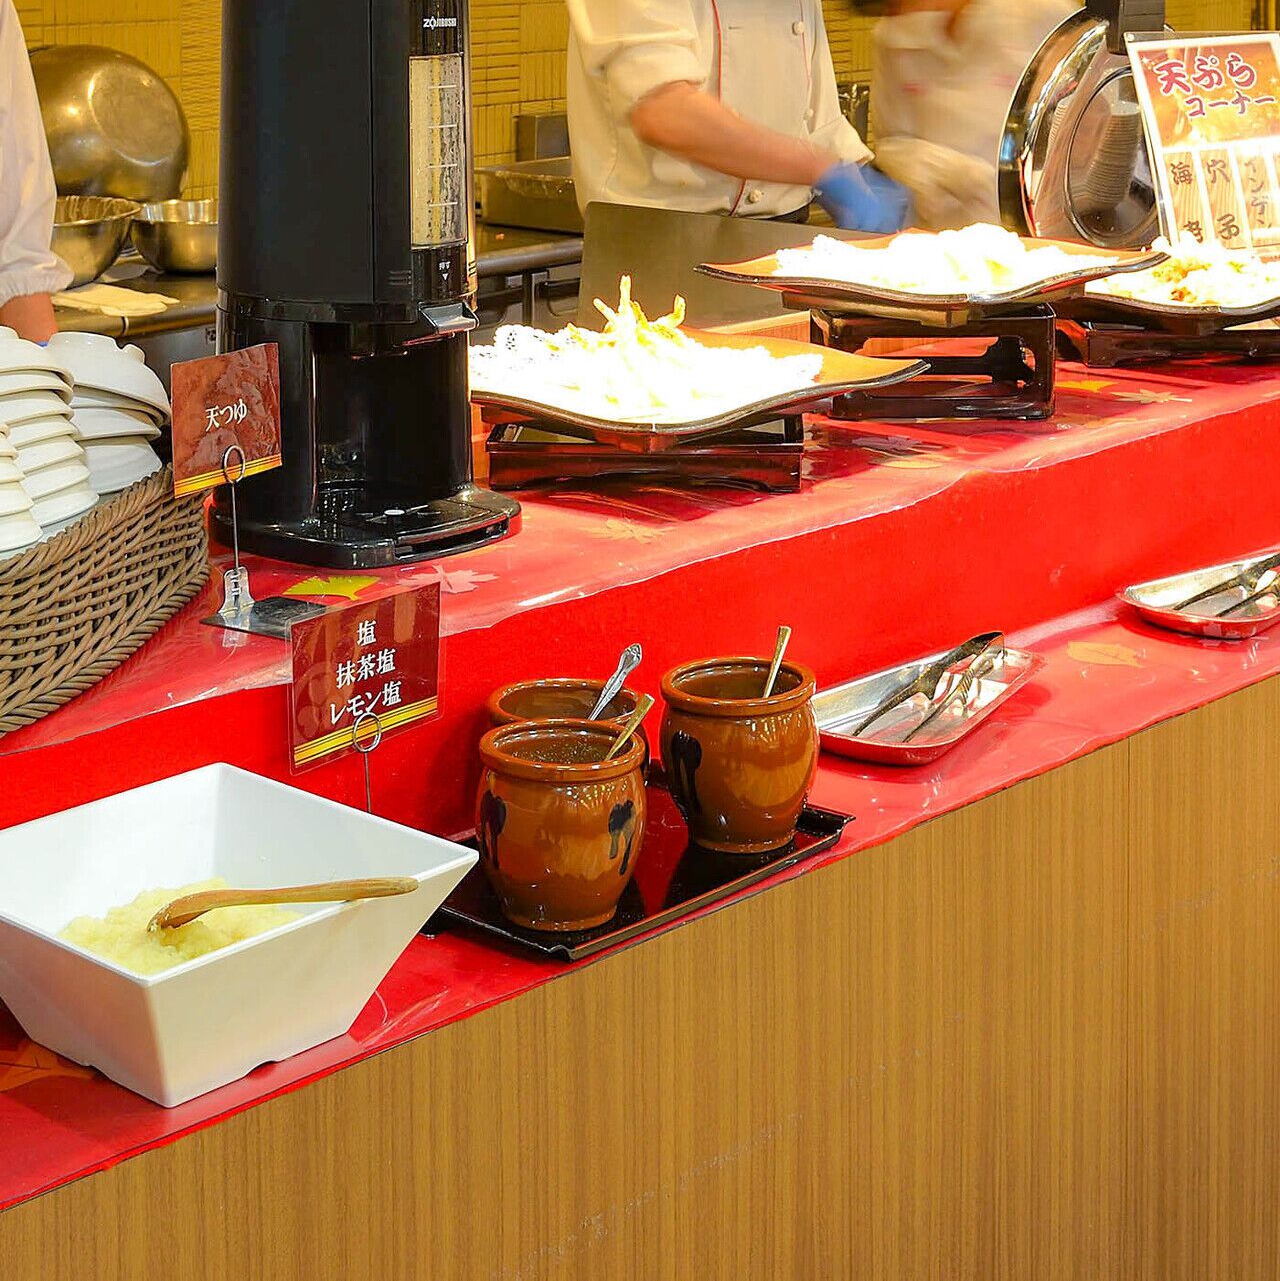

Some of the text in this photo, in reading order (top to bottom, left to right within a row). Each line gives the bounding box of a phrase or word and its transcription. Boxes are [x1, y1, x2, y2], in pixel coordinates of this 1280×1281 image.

[1154, 53, 1257, 95] 天ぷら
[1185, 90, 1276, 118] コーナー
[1206, 158, 1241, 241] 穴子
[204, 398, 248, 432] 天つゆ
[356, 620, 378, 647] 塩
[335, 647, 397, 690] 抹茶塩
[329, 680, 403, 726] レモン塩
